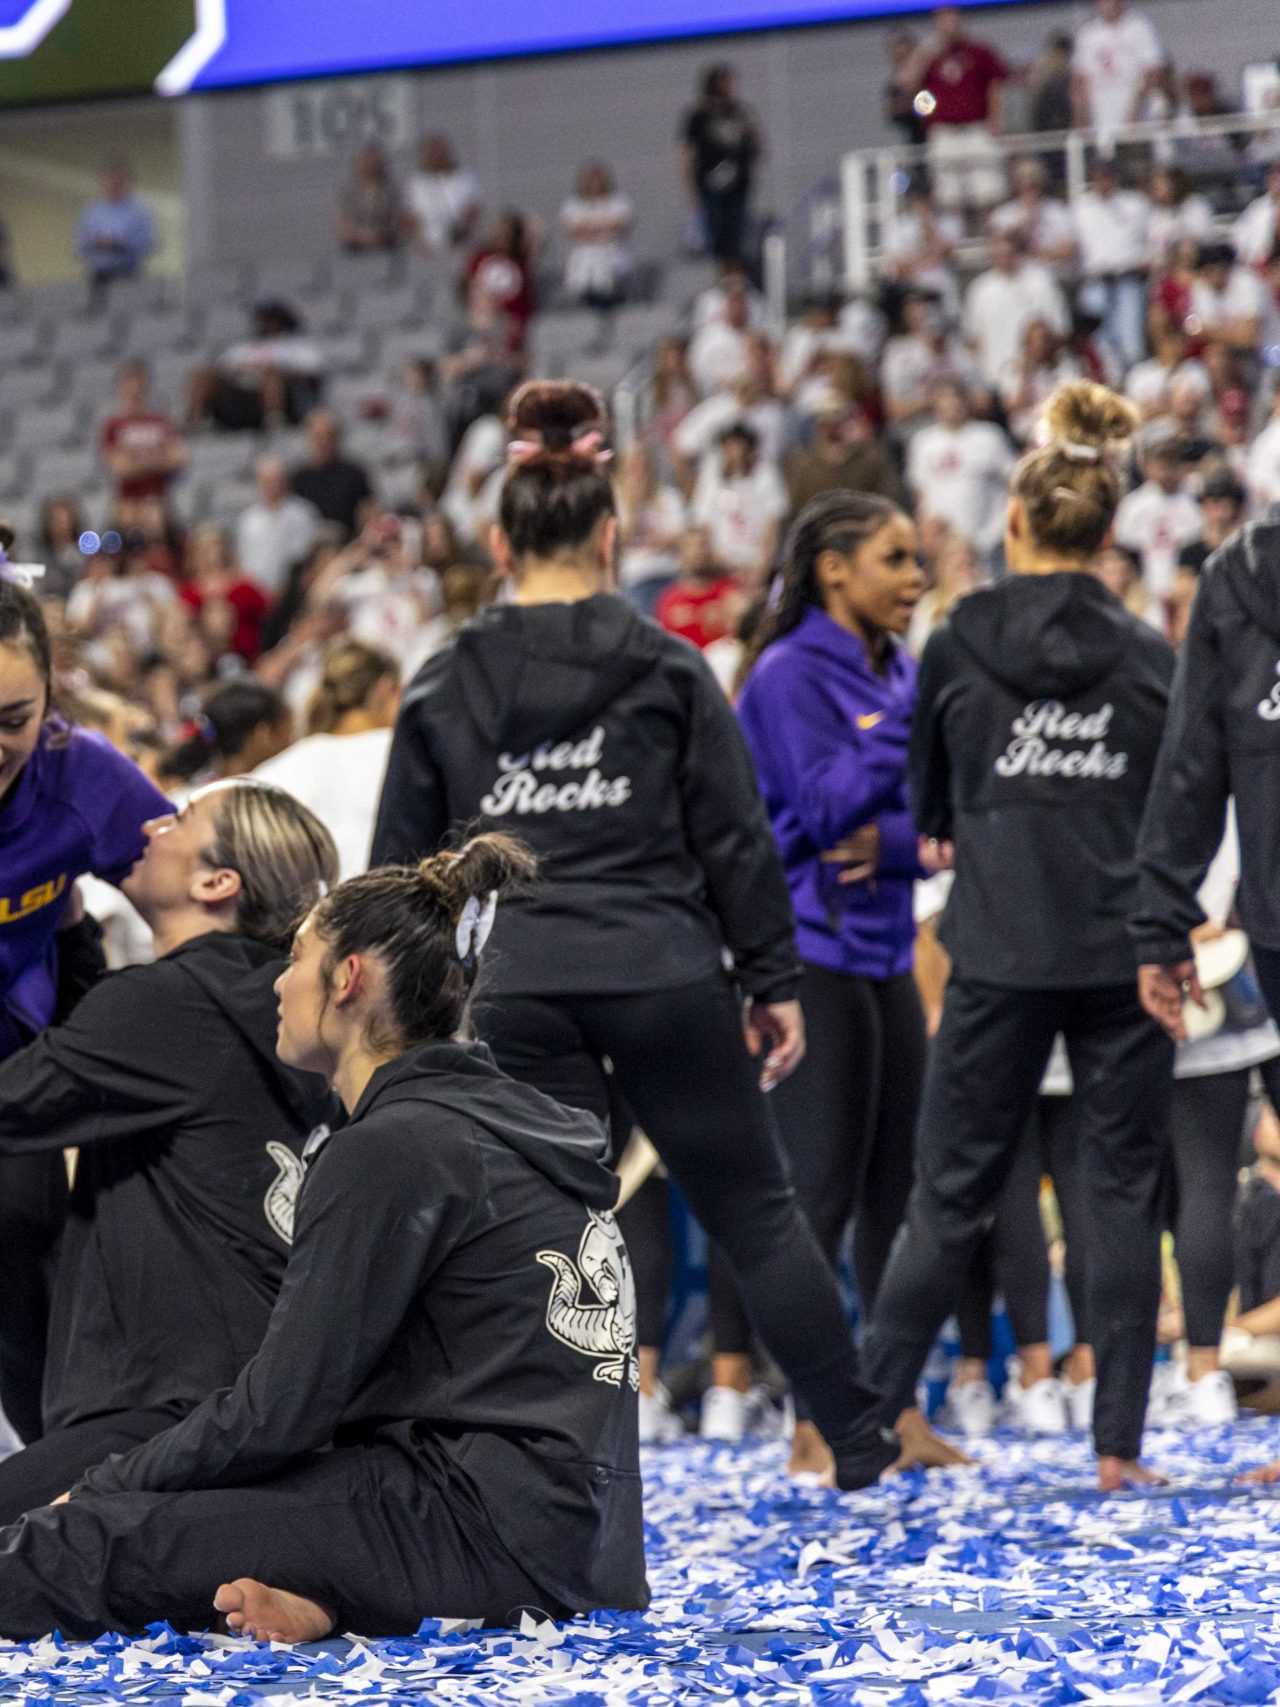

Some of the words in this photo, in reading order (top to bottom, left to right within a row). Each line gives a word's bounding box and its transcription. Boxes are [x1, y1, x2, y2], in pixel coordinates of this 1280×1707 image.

[1011, 699, 1115, 741] Red
[994, 735, 1129, 779] Rocks
[480, 768, 633, 816] Rocks
